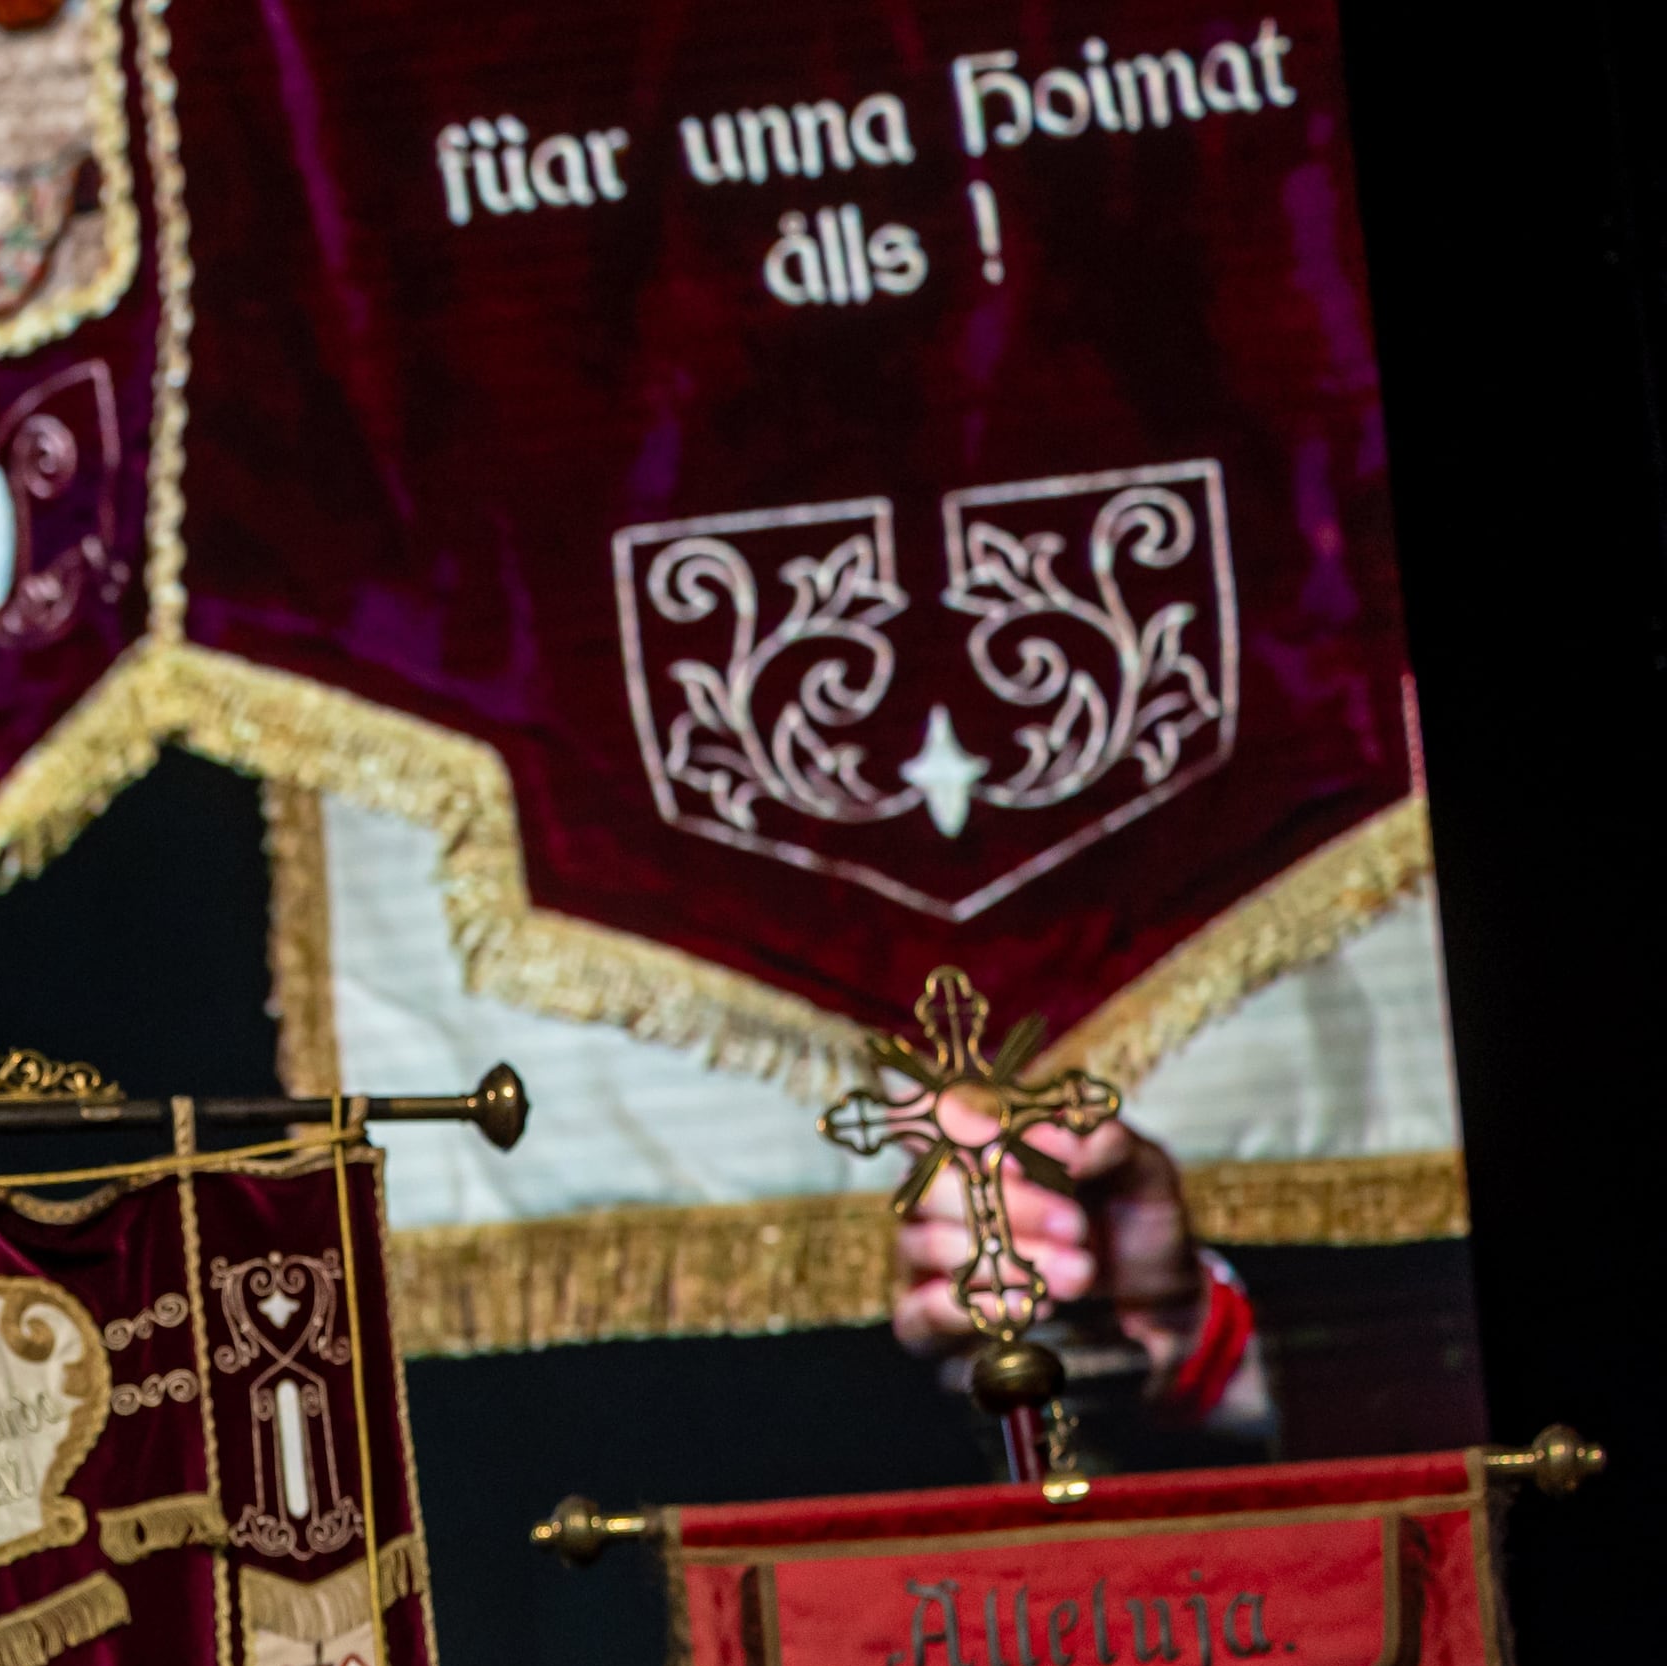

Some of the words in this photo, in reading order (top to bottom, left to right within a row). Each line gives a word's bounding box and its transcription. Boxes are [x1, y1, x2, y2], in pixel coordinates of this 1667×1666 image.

[437, 114, 628, 225] füar
[679, 92, 915, 186] unna
[952, 17, 1296, 157] Hoimat
